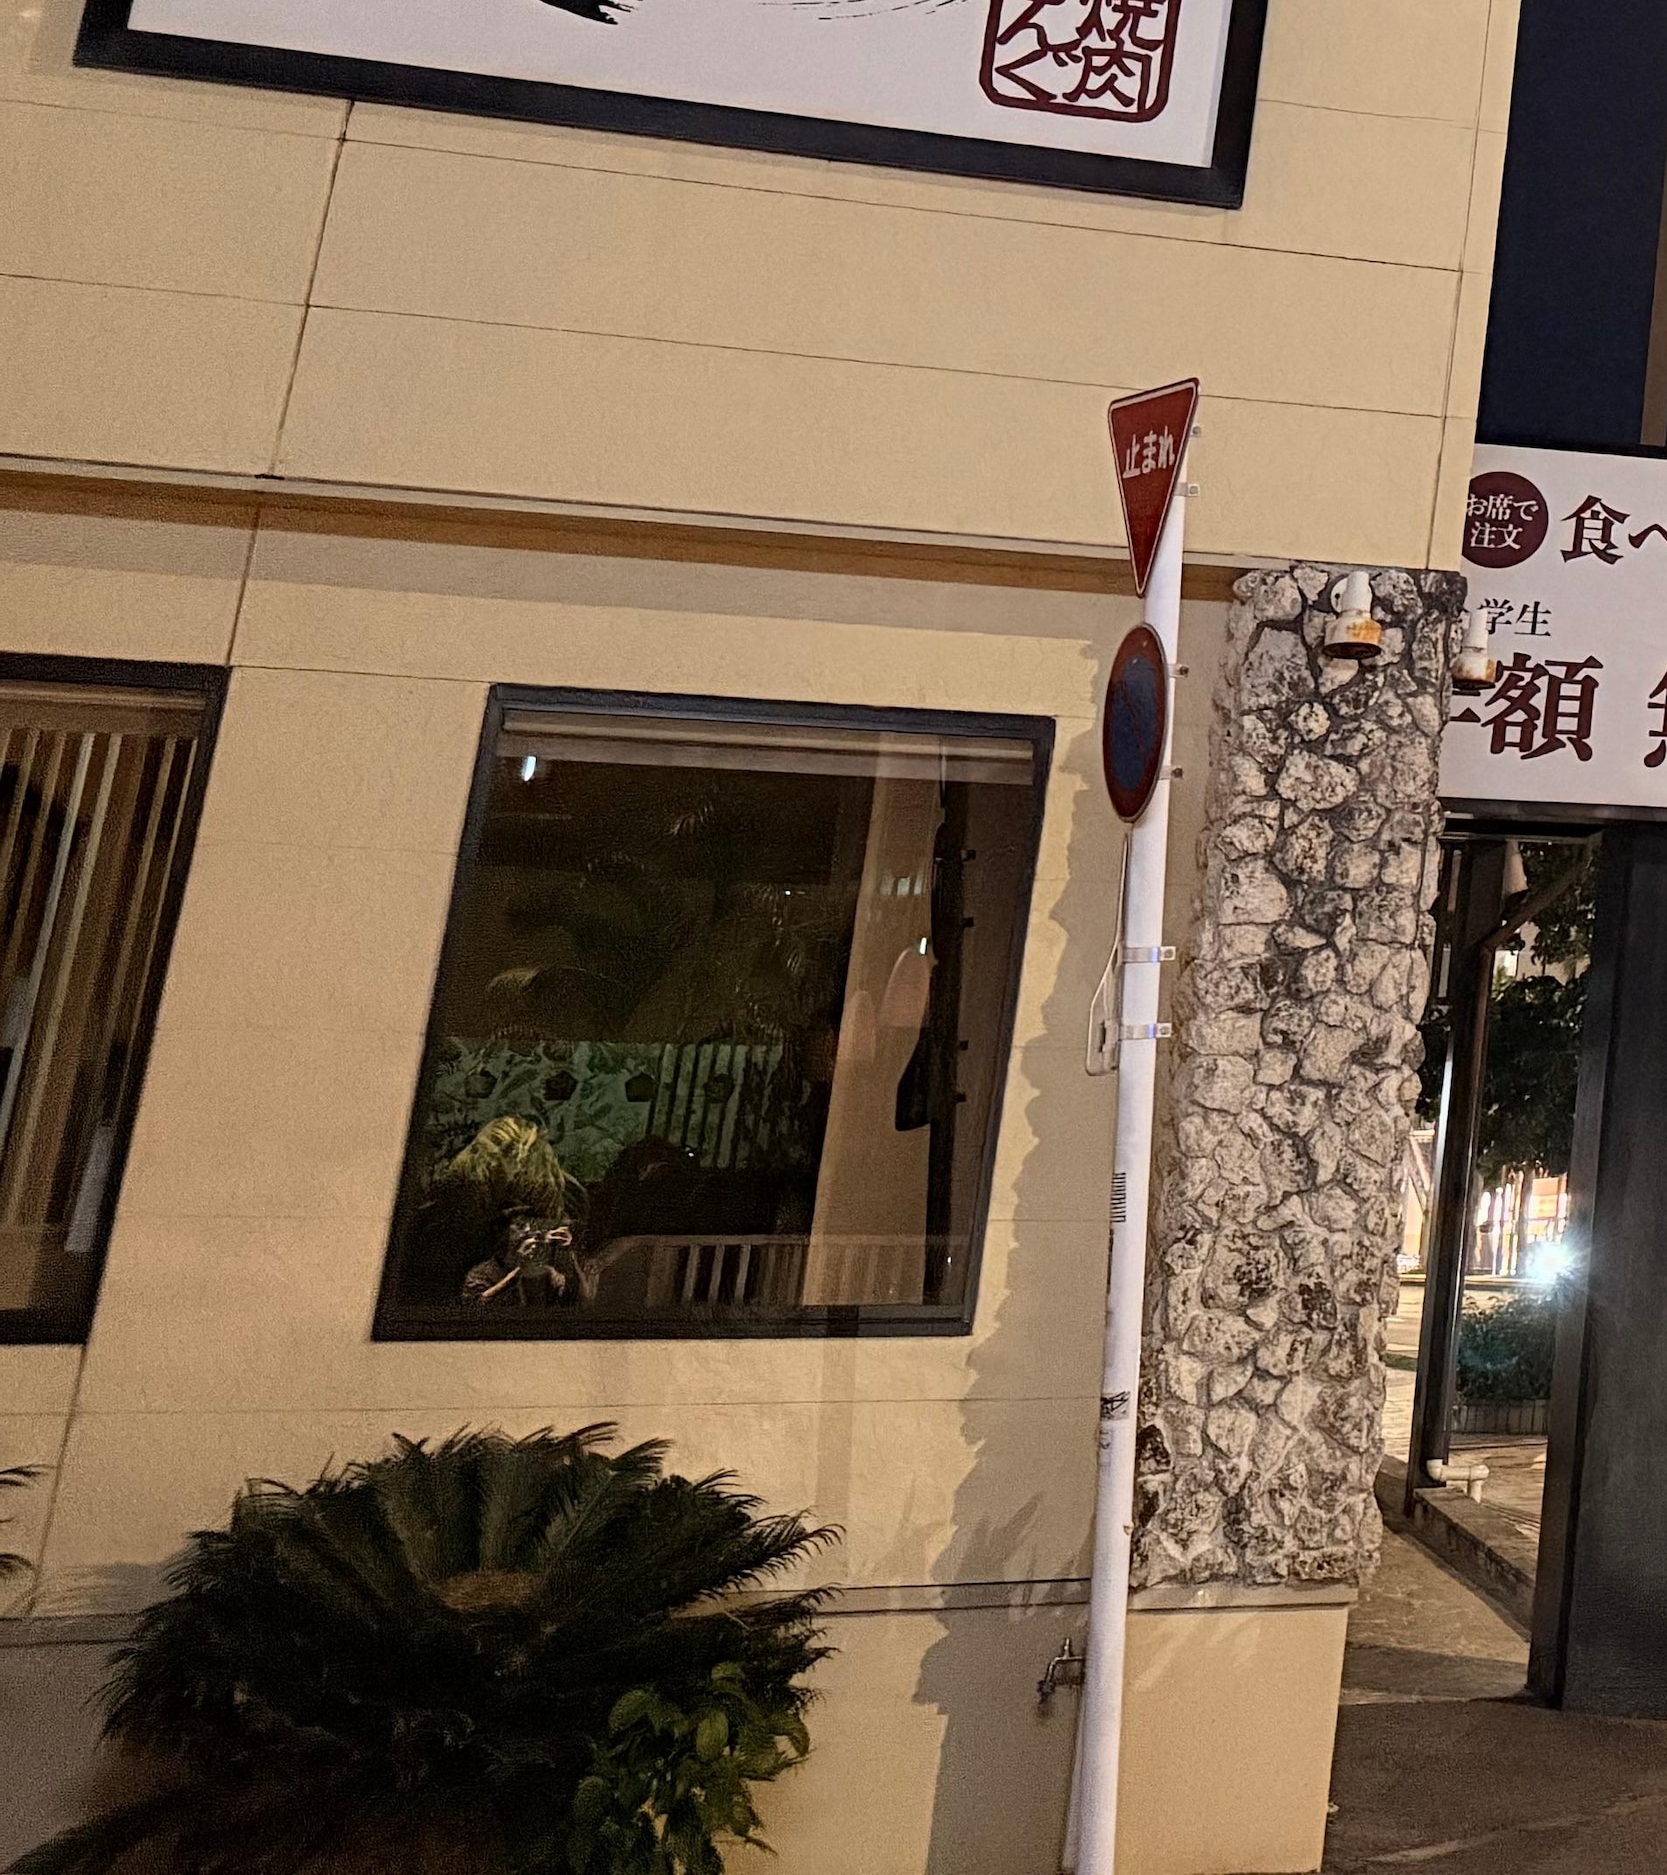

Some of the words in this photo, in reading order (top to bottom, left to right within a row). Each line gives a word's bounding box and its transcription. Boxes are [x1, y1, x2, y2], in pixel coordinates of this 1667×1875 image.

[1122, 425, 1176, 479] 止まれ
[1466, 493, 1539, 521] お席で
[1470, 521, 1523, 550] 注文
[1463, 599, 1552, 637] 学生
